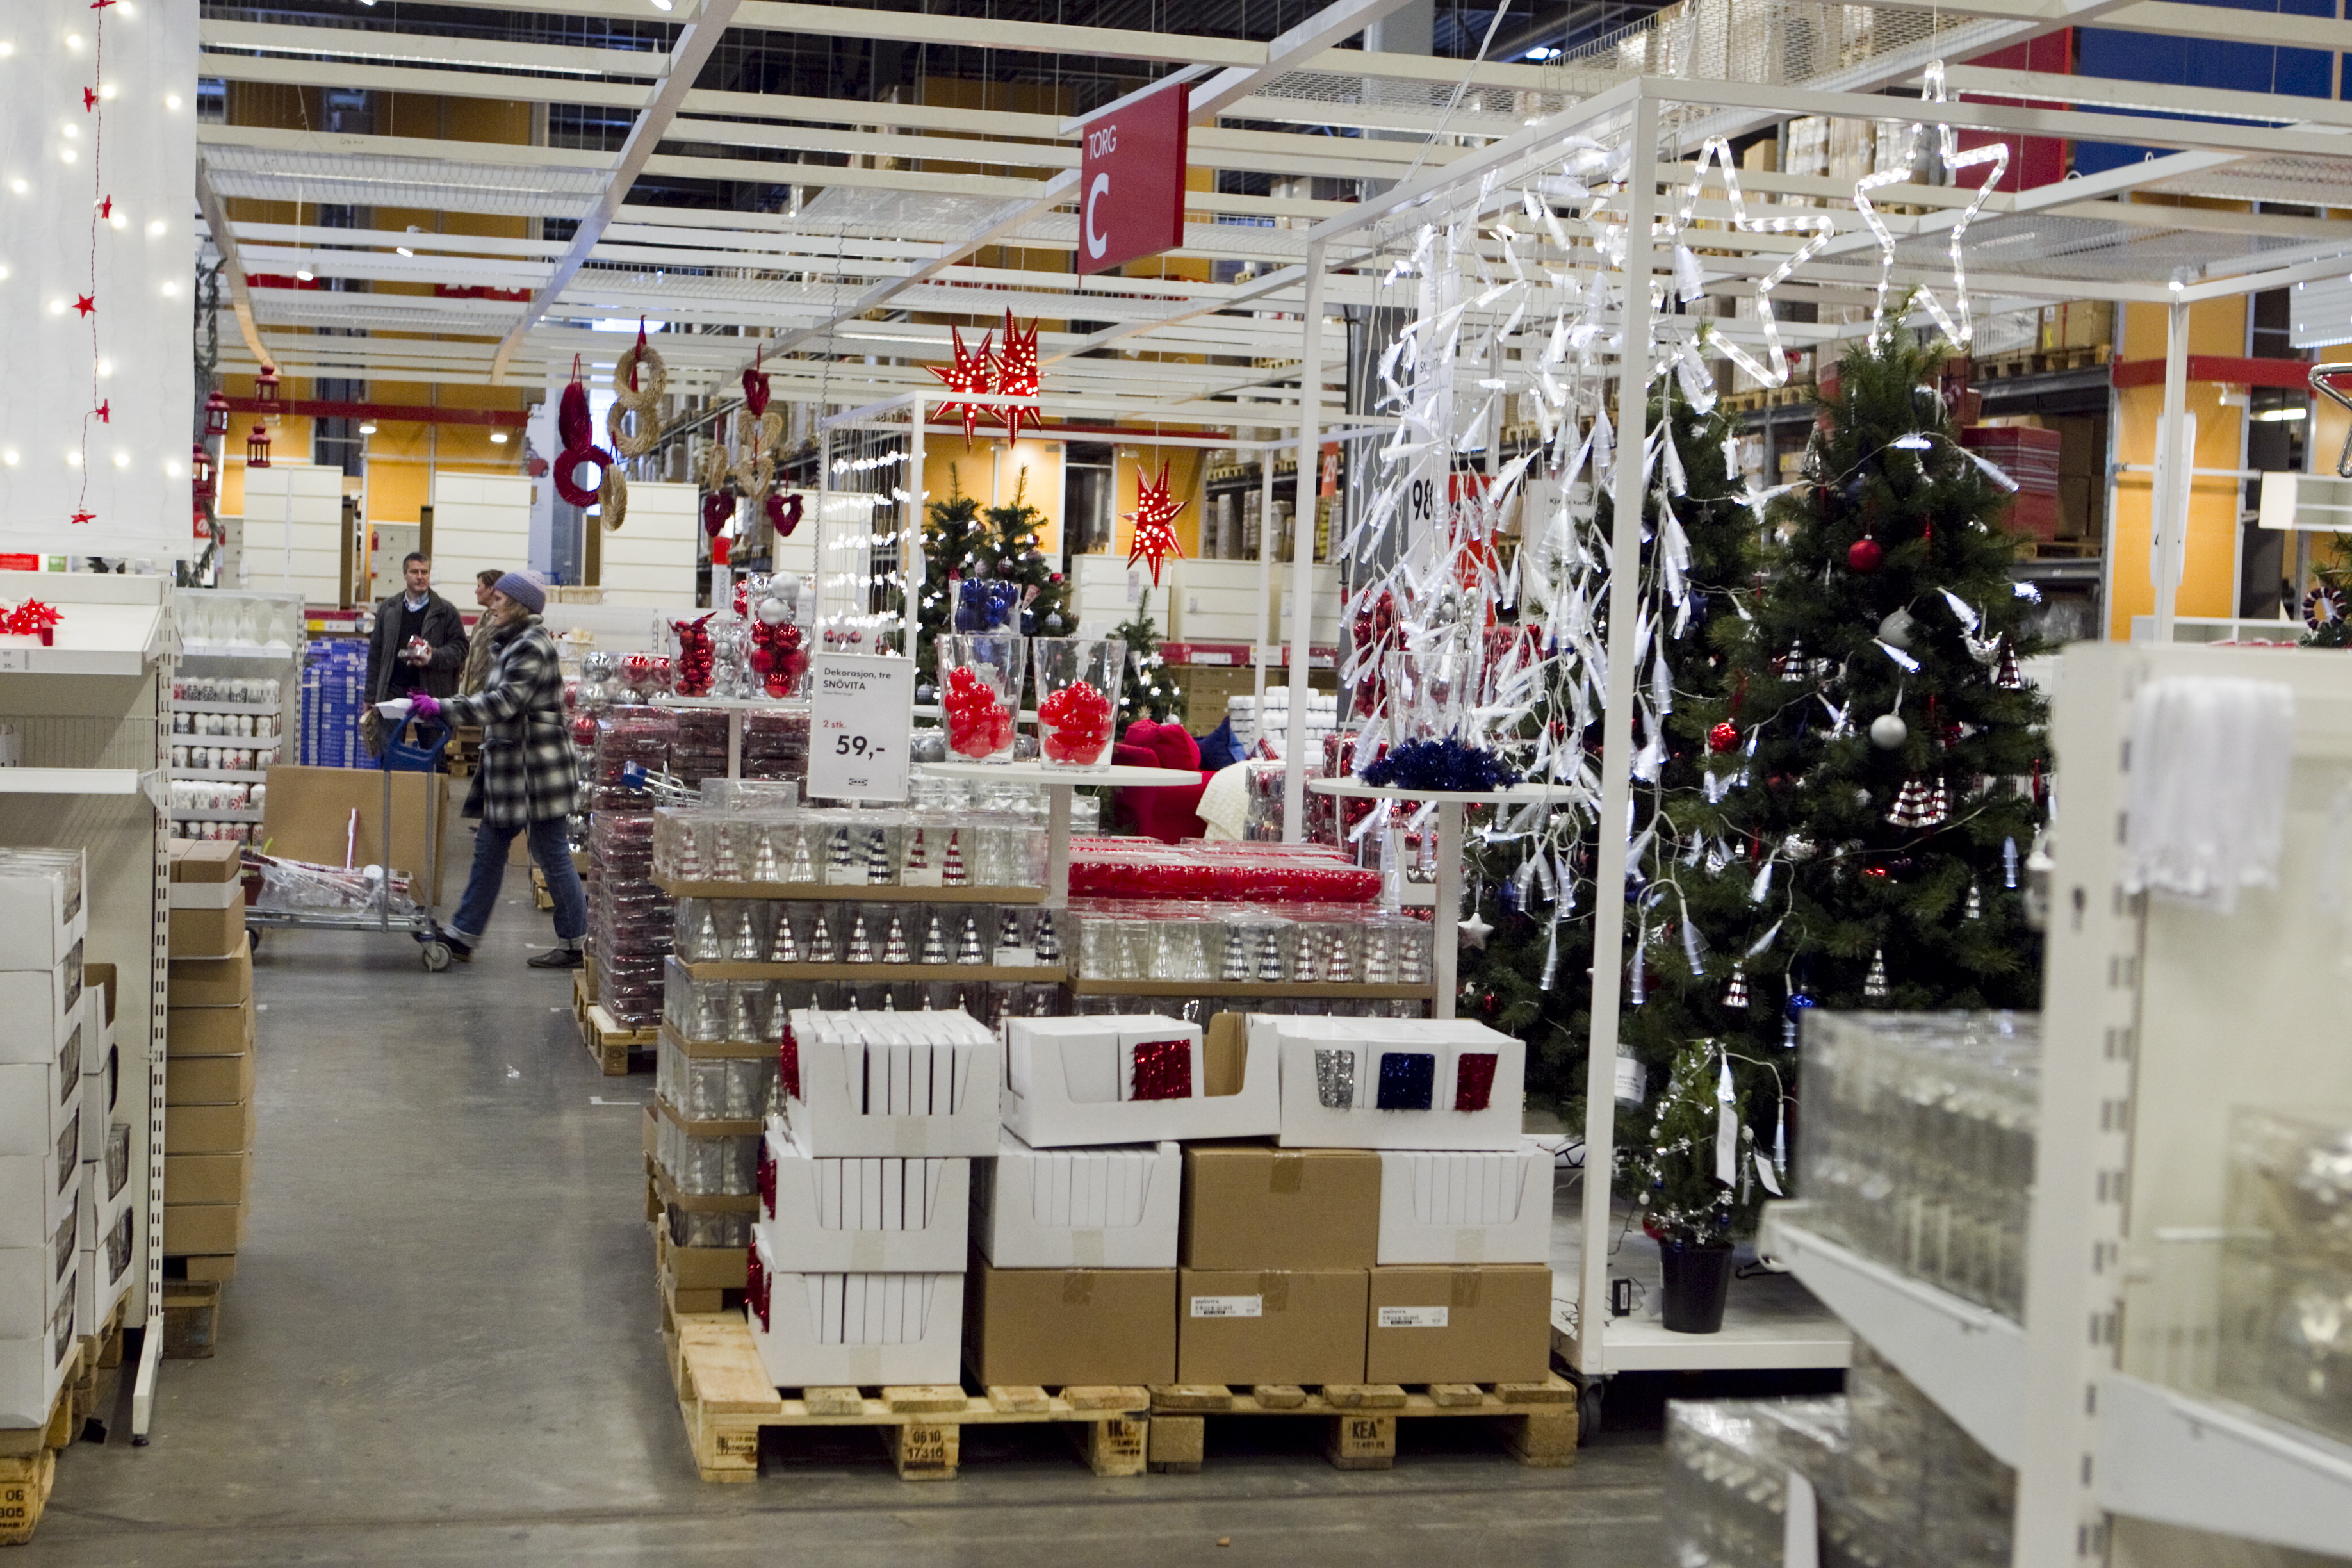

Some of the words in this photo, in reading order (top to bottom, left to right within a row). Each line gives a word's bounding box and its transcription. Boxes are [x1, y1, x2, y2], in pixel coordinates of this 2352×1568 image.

[1088, 124, 1117, 160] TORG
[1086, 172, 1109, 259] C
[1324, 454, 1337, 482] 29
[823, 679, 865, 690] SNÖVITA
[824, 667, 876, 679] Dekorasjon,
[835, 735, 885, 760] 59,-
[6, 1490, 24, 1501] 06
